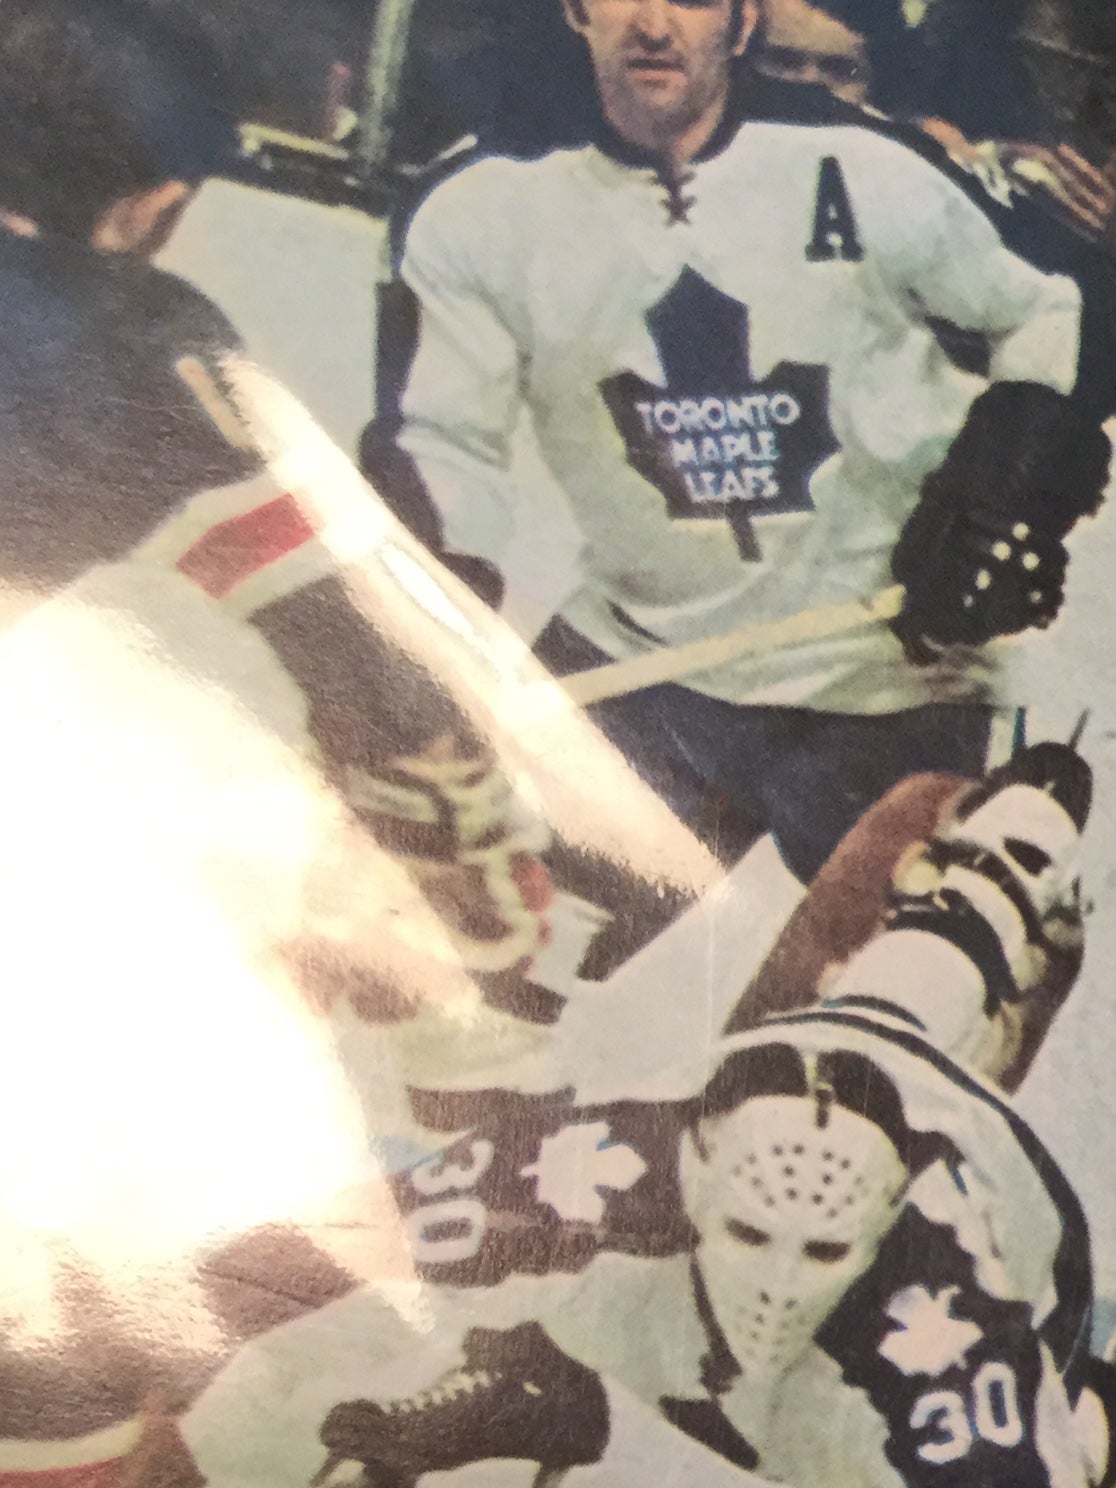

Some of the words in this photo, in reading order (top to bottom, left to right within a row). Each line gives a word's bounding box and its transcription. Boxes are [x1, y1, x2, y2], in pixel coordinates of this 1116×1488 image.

[805, 155, 864, 262] A
[635, 393, 800, 434] TORONTO
[671, 430, 780, 468] MAPLE
[685, 465, 779, 503] LEAFS
[405, 1138, 494, 1264] 30
[909, 1361, 1023, 1464] 30
